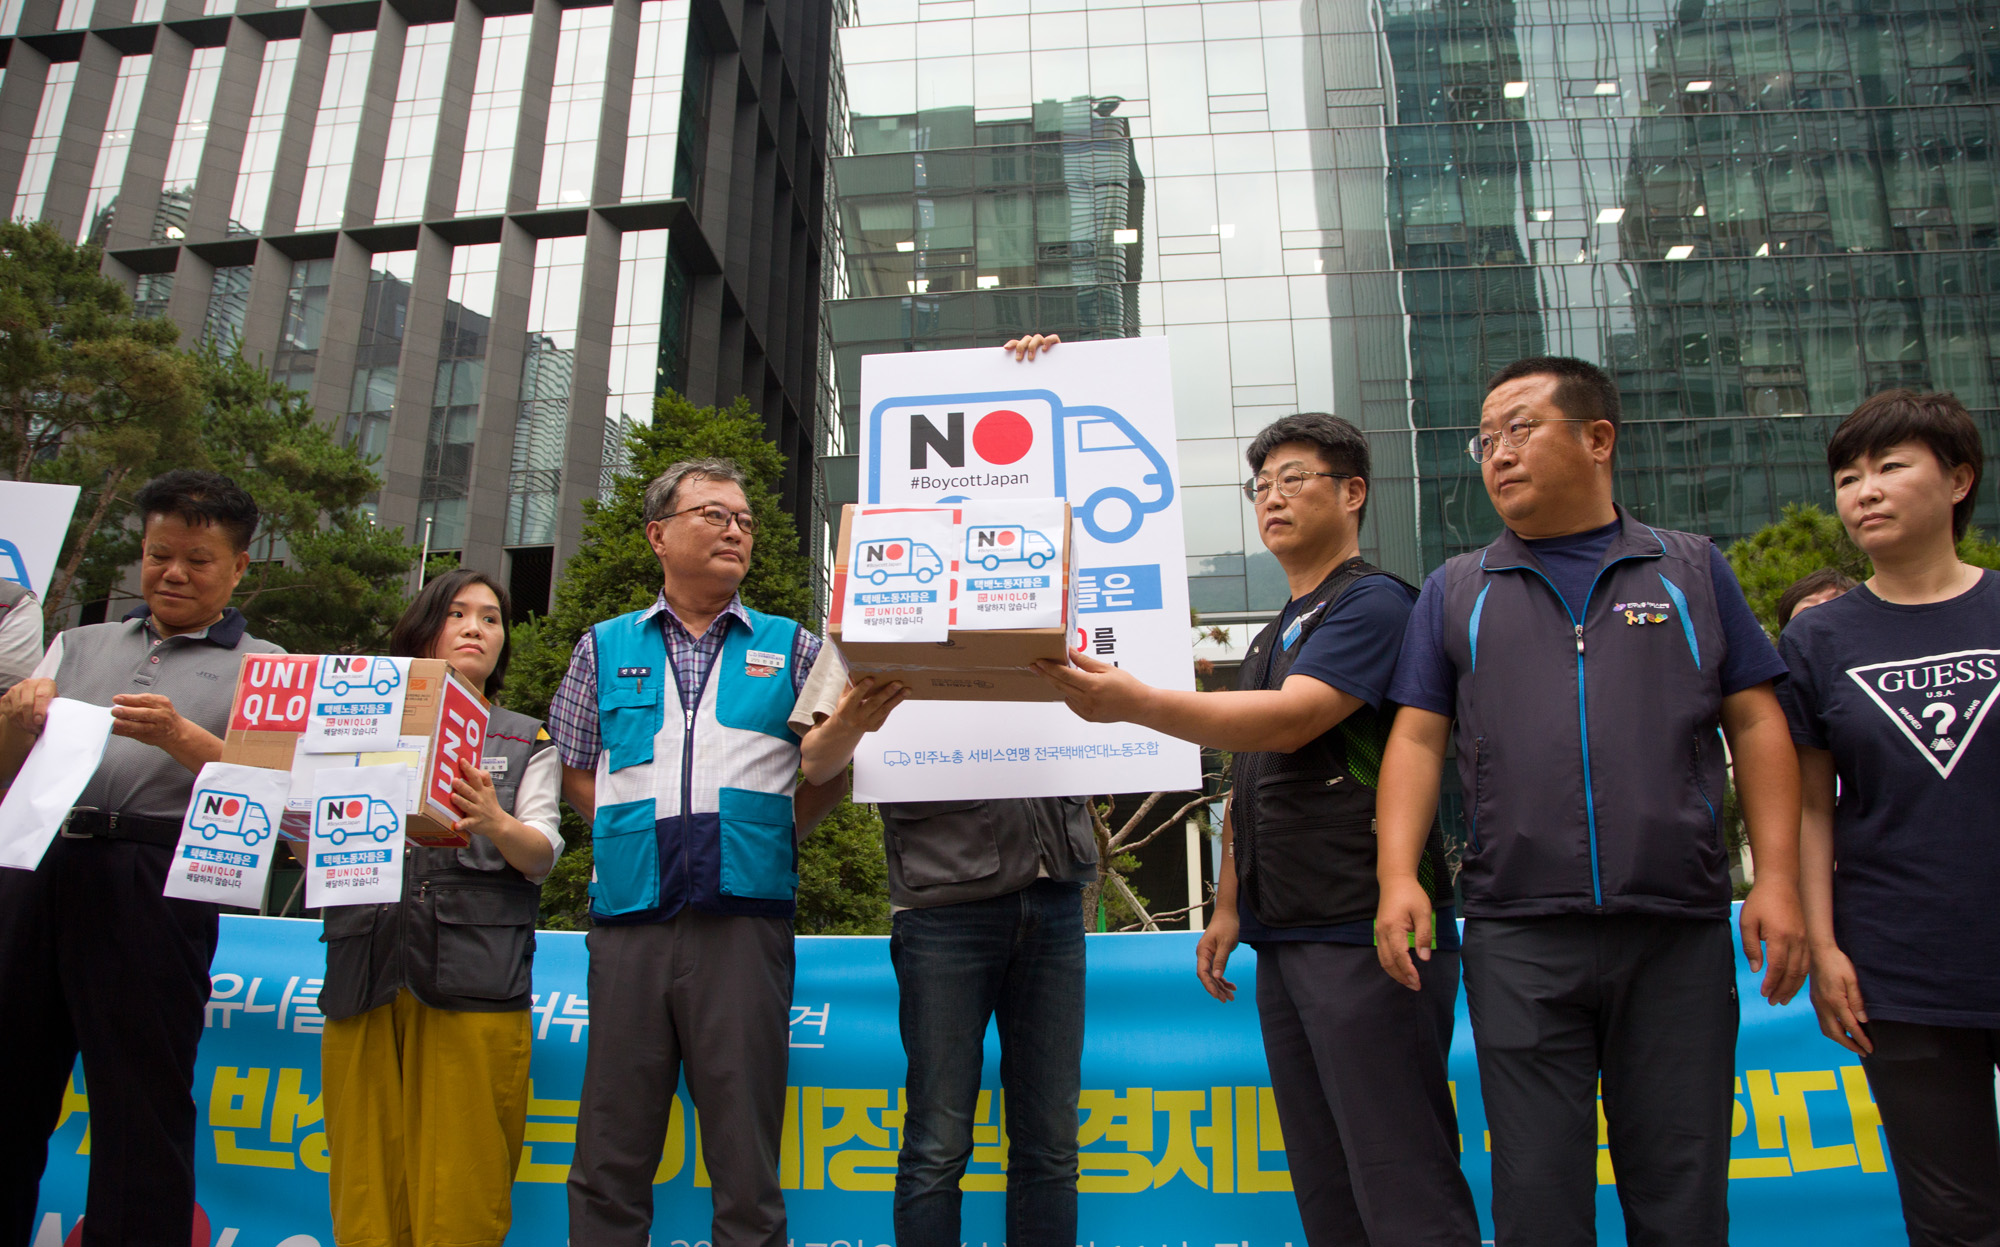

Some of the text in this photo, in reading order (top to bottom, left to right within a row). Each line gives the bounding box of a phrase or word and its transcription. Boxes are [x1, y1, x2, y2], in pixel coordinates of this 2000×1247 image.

[911, 472, 1029, 491] #BoycottJapan
[974, 577, 1043, 590] 택배노동자들은
[862, 592, 930, 604] 택배노동자들은
[977, 602, 1037, 612] 배달하지 않습니다
[864, 616, 924, 626] 배달하지 않습니다
[250, 661, 309, 689] UNI
[1877, 658, 1998, 692] GUESS
[1925, 690, 1955, 698] U.S.A.
[243, 693, 307, 726] QLO
[324, 703, 386, 715] 택배노동자들은
[1963, 699, 1981, 720] JEANS
[1898, 706, 1923, 730] WASHED
[324, 727, 378, 736] 배달하지 않습니다
[438, 708, 465, 794] UNI
[914, 741, 1160, 765] 민주노총 서비스연맹 전국택배연대노동조합
[190, 848, 252, 866] 택배노동자들은
[323, 851, 386, 865] 택배노동자들은
[186, 873, 242, 889] 배달하지 않습니다
[325, 877, 379, 888] 배달하지 않습니다
[204, 973, 326, 1034] 유니클
